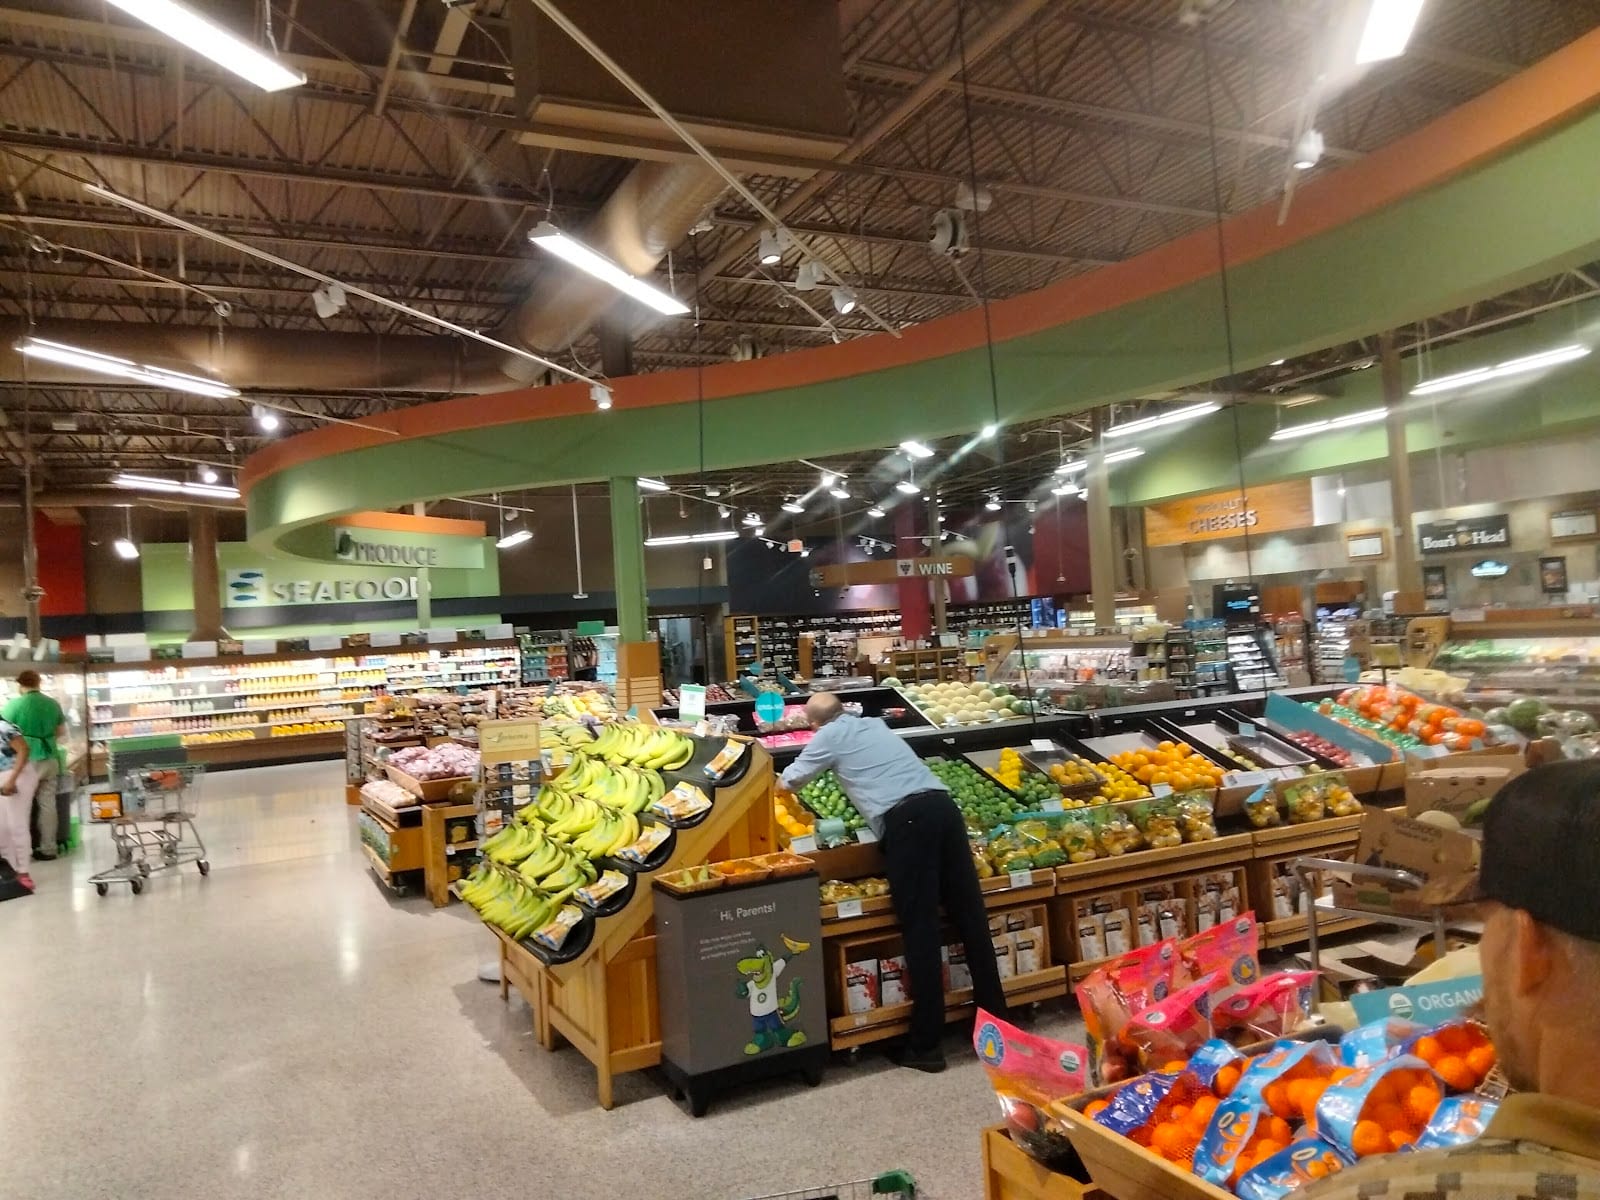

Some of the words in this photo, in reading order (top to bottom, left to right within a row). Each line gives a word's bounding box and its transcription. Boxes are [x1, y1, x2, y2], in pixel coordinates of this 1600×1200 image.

[1188, 510, 1258, 534] CHEESES
[1471, 528, 1506, 545] Head
[353, 542, 437, 566] PRODUCE
[919, 562, 953, 575] WINE
[720, 910, 734, 921] Hi,
[736, 901, 777, 918] Parents!
[1418, 988, 1483, 1010] ORGANI
